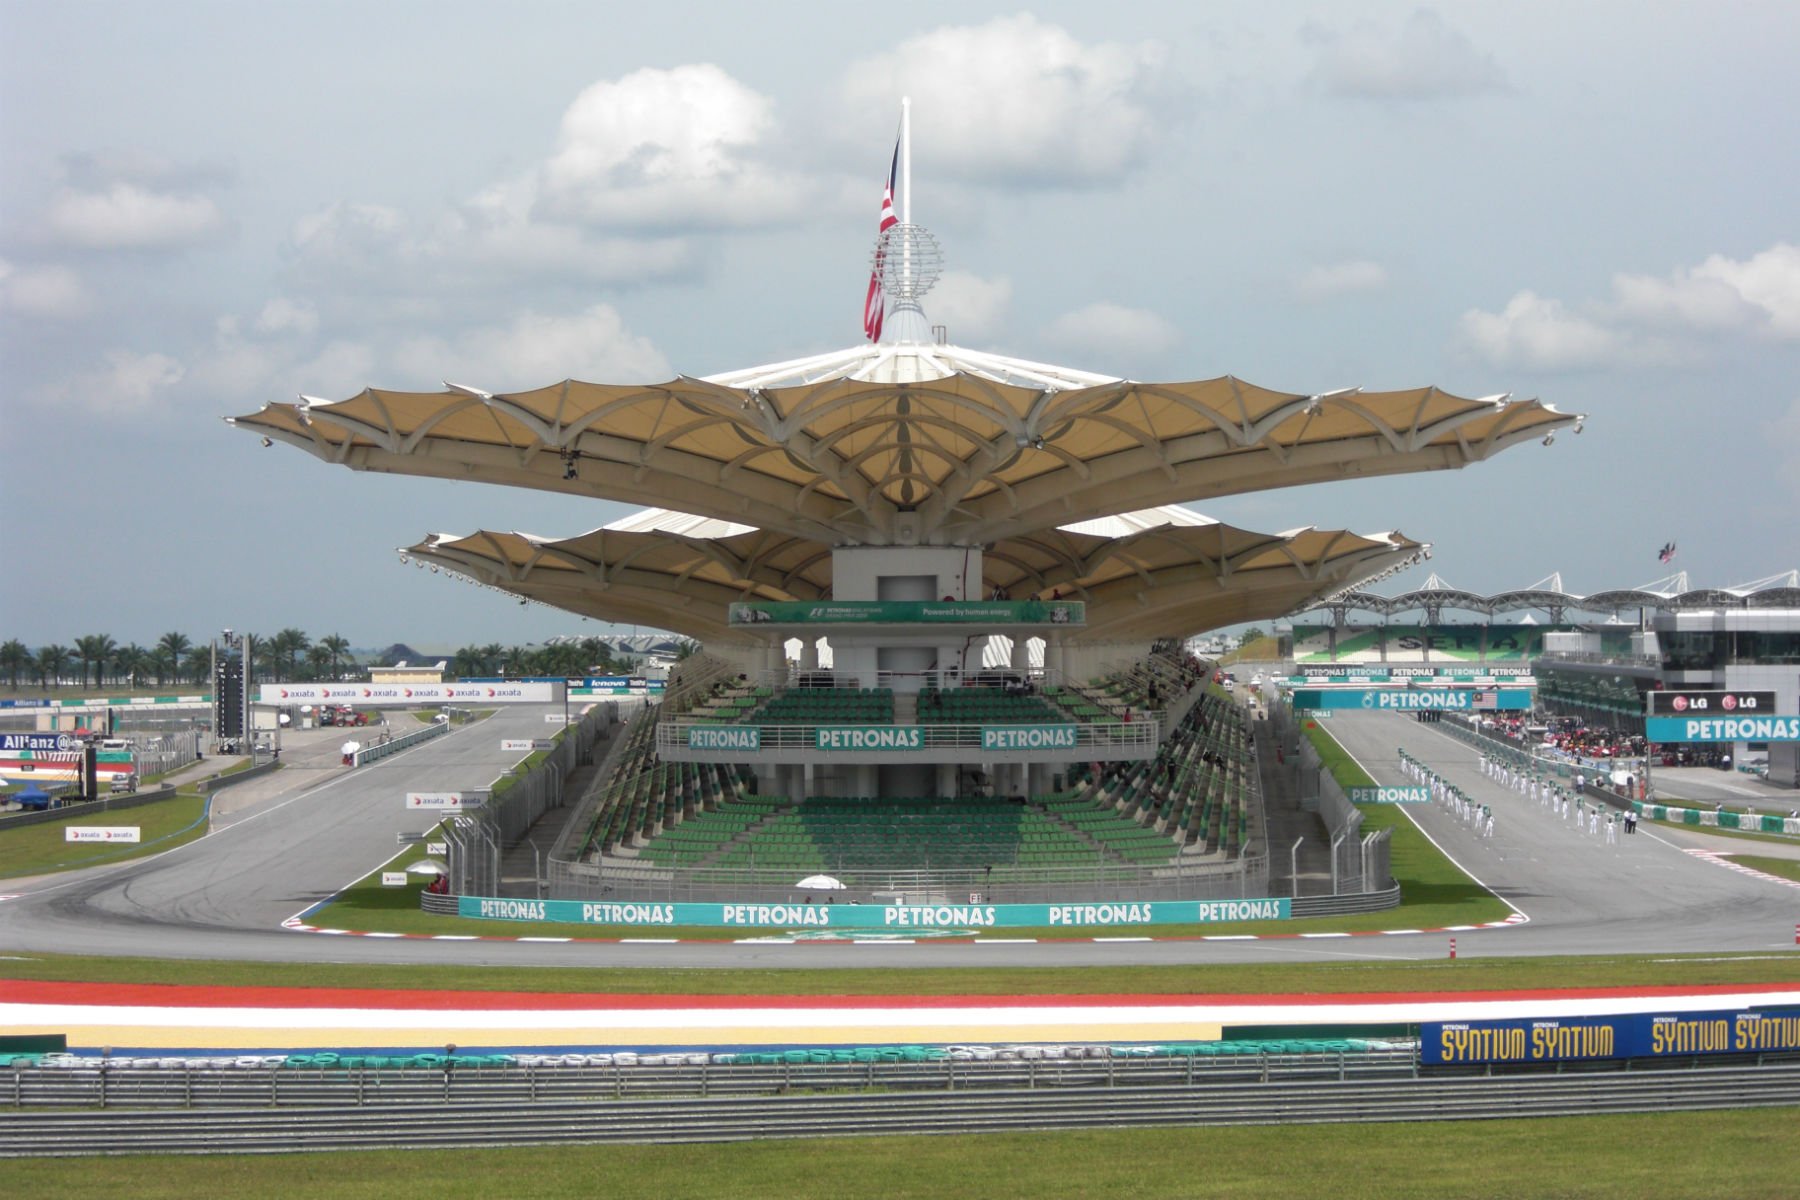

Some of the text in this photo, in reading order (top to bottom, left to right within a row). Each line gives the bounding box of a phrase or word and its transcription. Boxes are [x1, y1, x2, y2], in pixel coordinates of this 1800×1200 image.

[922, 608, 954, 616] Powered
[955, 608, 965, 617] by
[965, 608, 989, 616] human
[1346, 668, 1388, 676] PETRONAS
[1392, 668, 1434, 676] PETRONAS
[1444, 668, 1484, 676] PETRONAS
[1490, 668, 1531, 676] PETRONAS
[290, 688, 522, 698] axiata axiata axiata axiata axiata axiata
[1379, 692, 1467, 708] PETRONAS
[1690, 697, 1757, 709] LG LG
[819, 729, 919, 747] PETRONAS
[985, 728, 1075, 747] PETRONAS
[1686, 719, 1800, 739] PETRONAS
[690, 730, 757, 747] PETRONAS
[1352, 788, 1429, 802] PETRONAS
[481, 900, 546, 920] PETRONAS
[582, 903, 674, 923] PETRONAS
[722, 905, 829, 925] PETRONAS
[884, 907, 995, 926] PETRONAS
[1049, 904, 1152, 925] PETRONAS
[1199, 900, 1281, 921] PETRONAS
[1441, 1028, 1525, 1061] SYNTIUM
[1532, 1026, 1614, 1059] SYNTIUM
[1652, 1020, 1729, 1053] SYNTIUM
